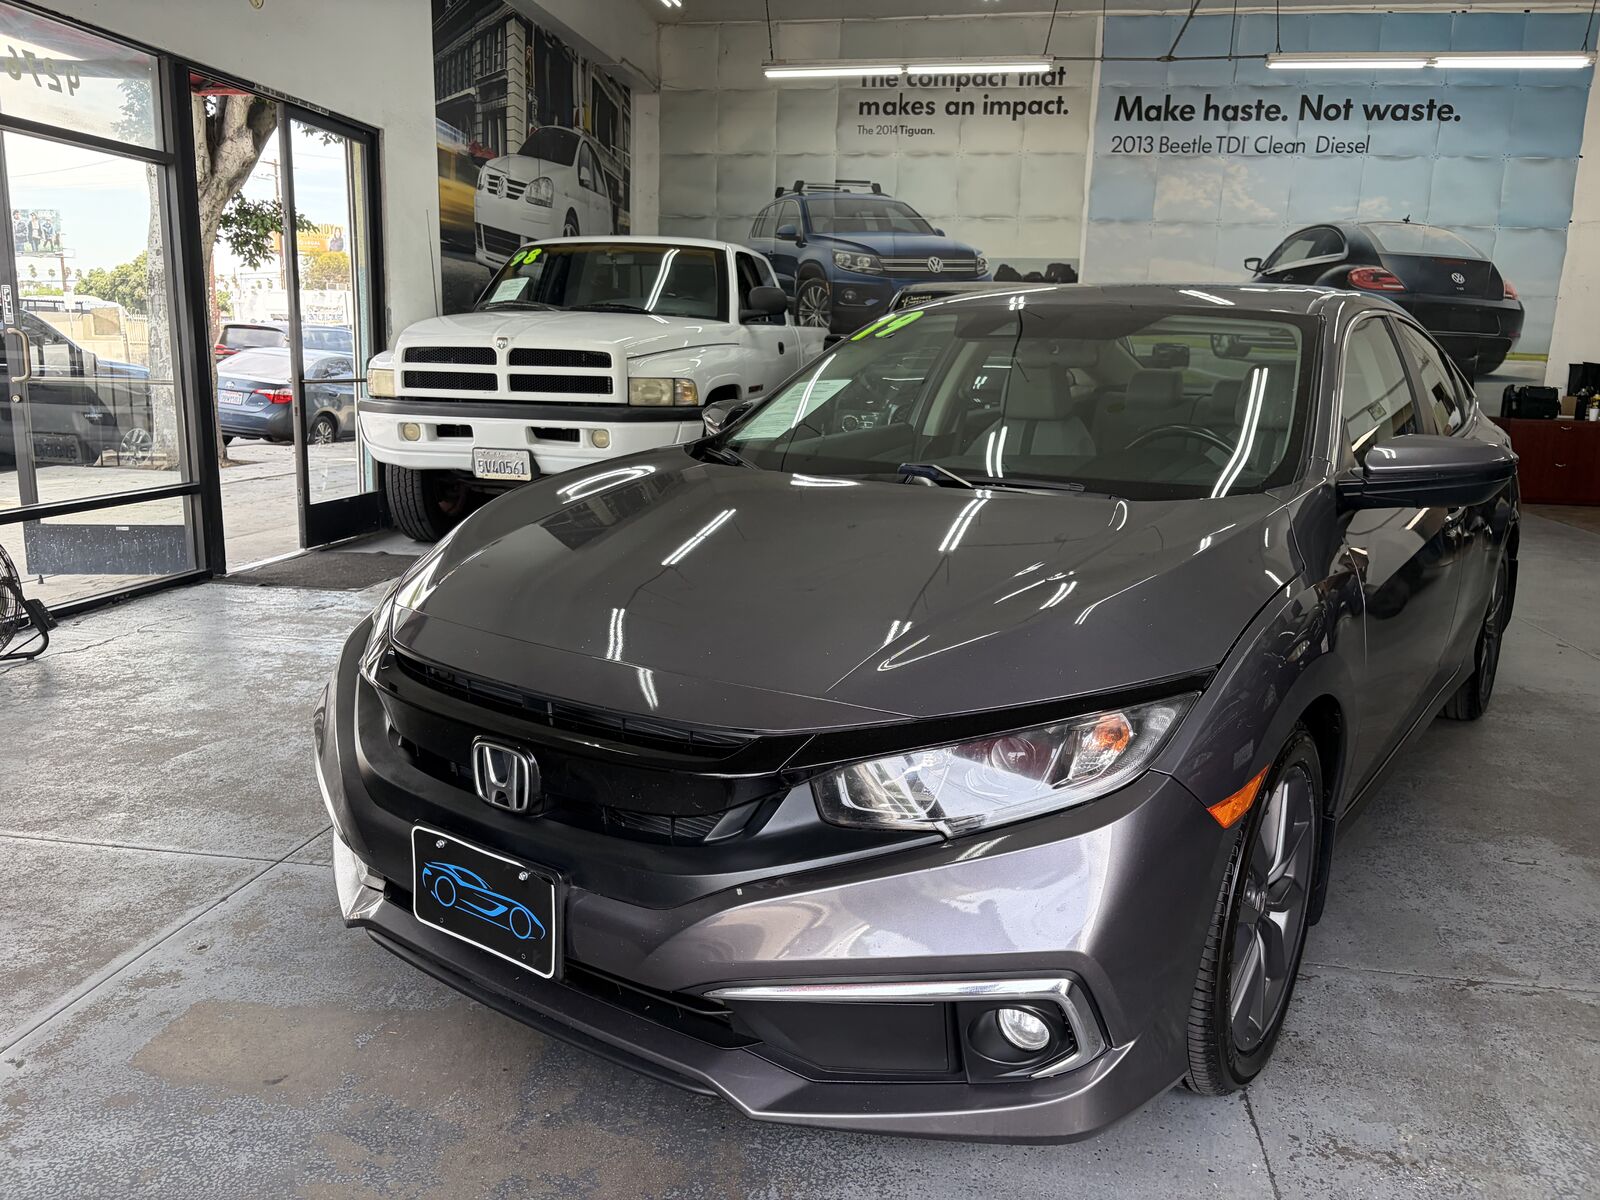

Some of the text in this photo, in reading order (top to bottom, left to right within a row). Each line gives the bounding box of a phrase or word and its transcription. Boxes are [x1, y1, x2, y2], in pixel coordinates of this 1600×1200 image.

[859, 92, 1069, 121] makes an impact.
[1113, 93, 1461, 122] Make haste. Not waste.
[857, 125, 935, 138] The 2014 Tiguan.
[1111, 135, 1154, 154] 2013
[1159, 135, 1212, 154] Beetle
[1254, 135, 1306, 154] Clean
[1316, 135, 1371, 154] Diesel
[510, 248, 542, 267] 98
[4, 288, 12, 315] PULL
[850, 311, 924, 341] 19
